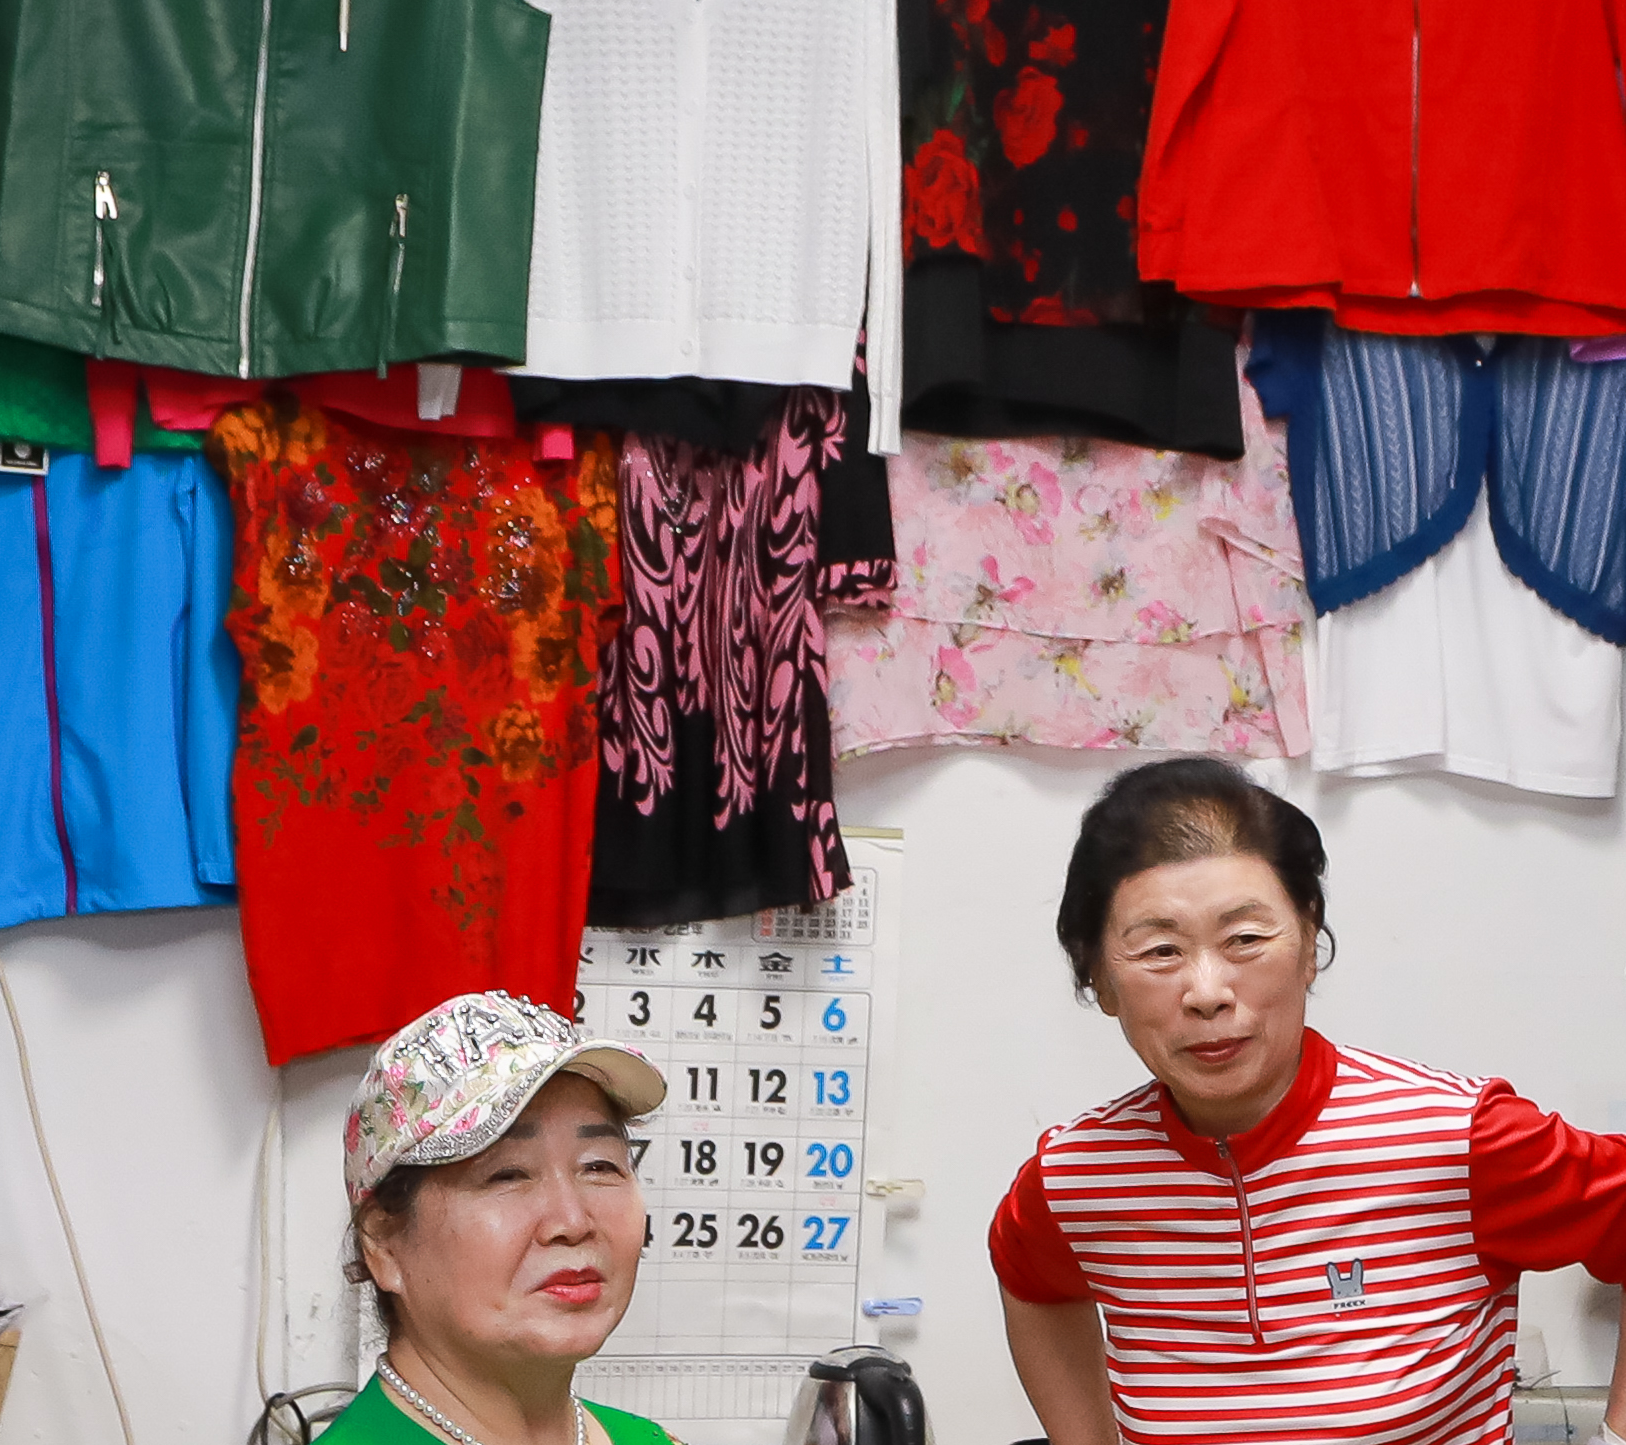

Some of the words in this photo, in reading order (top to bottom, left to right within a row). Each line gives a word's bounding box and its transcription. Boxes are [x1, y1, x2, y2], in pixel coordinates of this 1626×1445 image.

[626, 948, 661, 967] 水
[692, 950, 725, 969] 木
[759, 952, 792, 972] 金
[821, 955, 854, 974] 土
[628, 991, 650, 1027] 3
[693, 994, 717, 1028] 4
[760, 995, 781, 1030] 5
[823, 998, 846, 1032] 6
[687, 1067, 718, 1101] 11
[748, 1069, 787, 1103] 12
[813, 1070, 851, 1105] 13
[680, 1140, 716, 1175] 18
[744, 1142, 784, 1176] 19
[806, 1143, 853, 1178] 20
[672, 1213, 718, 1248] 25
[737, 1214, 784, 1250] 26
[803, 1216, 851, 1250] 27
